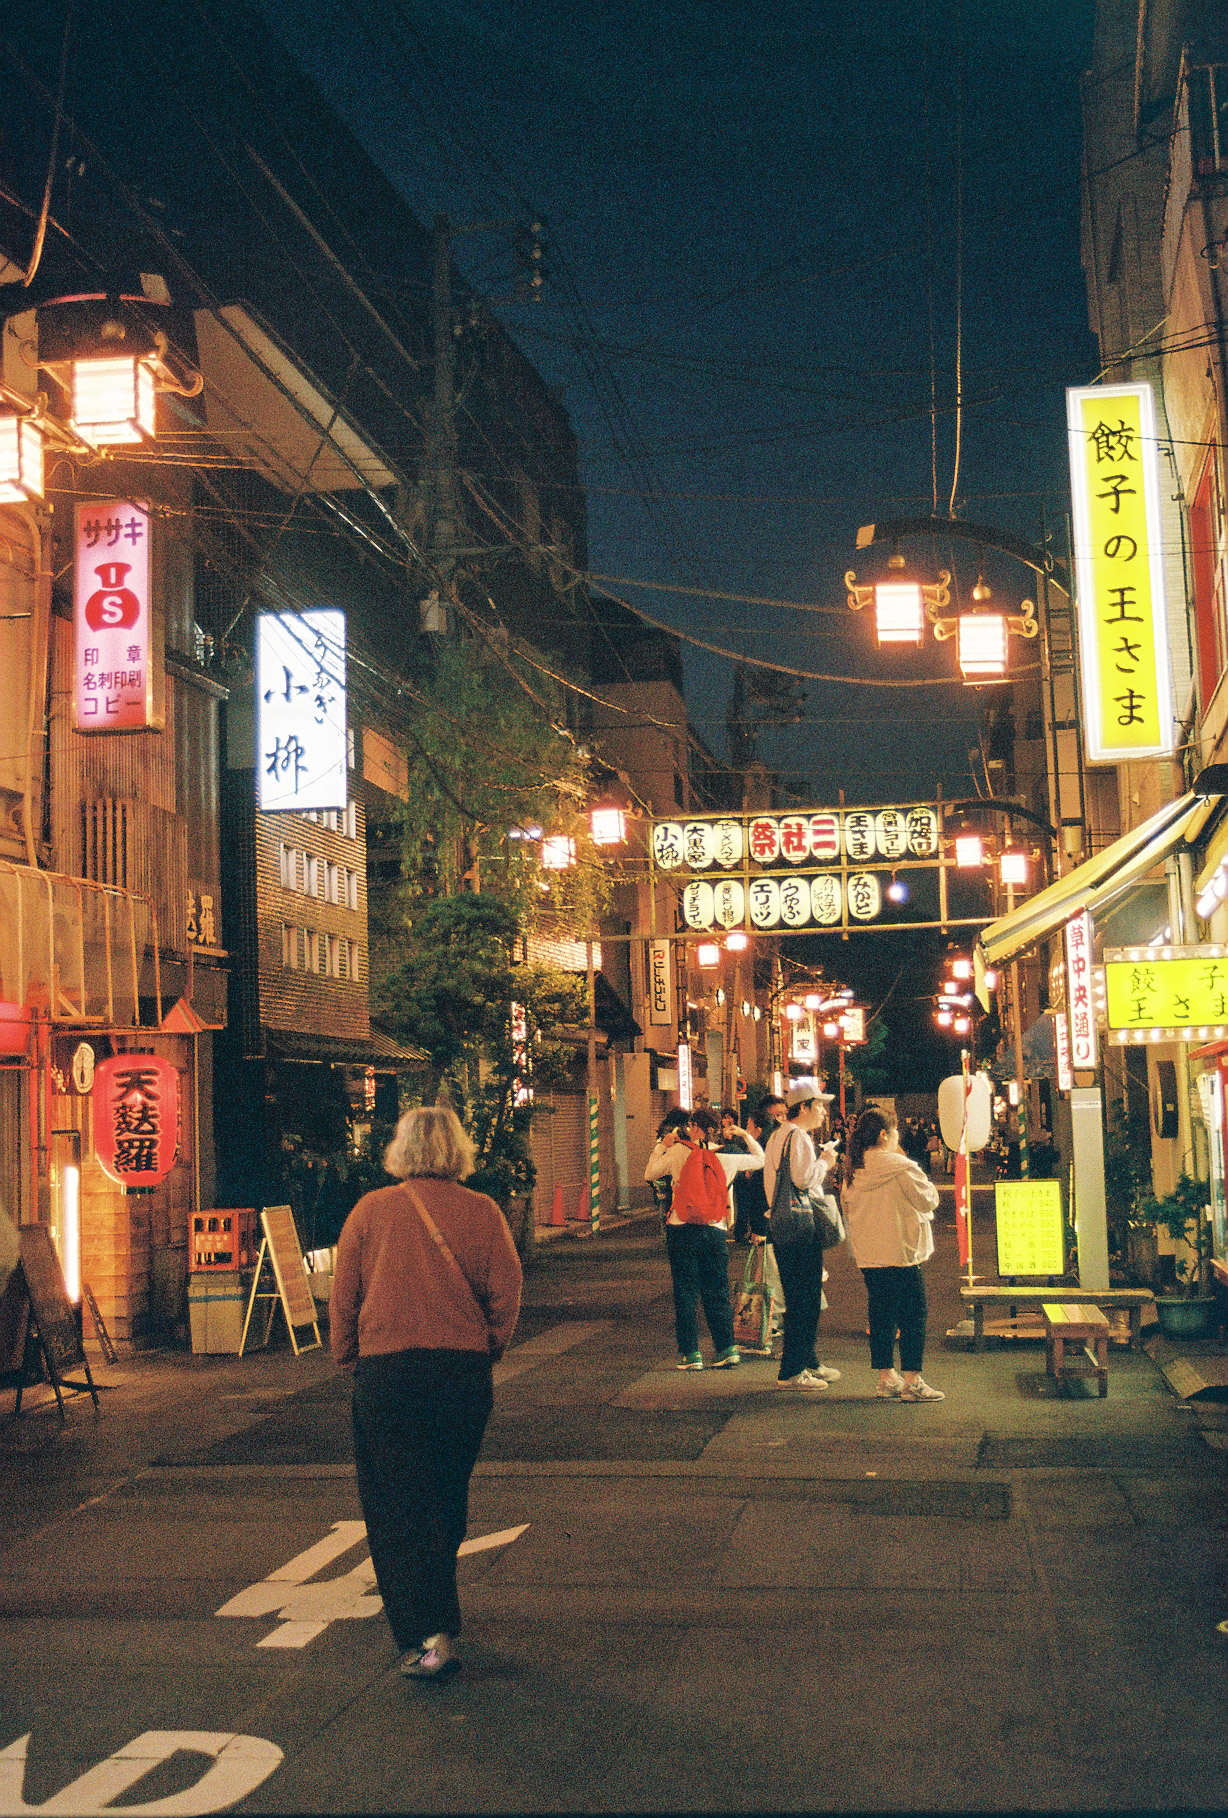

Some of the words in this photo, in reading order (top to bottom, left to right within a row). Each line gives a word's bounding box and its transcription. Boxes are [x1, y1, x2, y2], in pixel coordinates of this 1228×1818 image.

[83, 517, 143, 549] ササキ
[1087, 420, 1146, 726] 餃子の王さま
[83, 670, 142, 691] 名刺印刷
[313, 630, 336, 725] うなぎ
[83, 695, 140, 715] コピー
[264, 665, 309, 795] 小柳
[655, 826, 679, 866] 小柳
[686, 826, 705, 863] 大黒家
[850, 814, 869, 856] 王さま
[753, 883, 772, 921] エリッツ
[1069, 912, 1092, 1062] 草中央通り
[1128, 992, 1228, 1022] 王さま
[112, 1067, 161, 1172] 天麩羅
